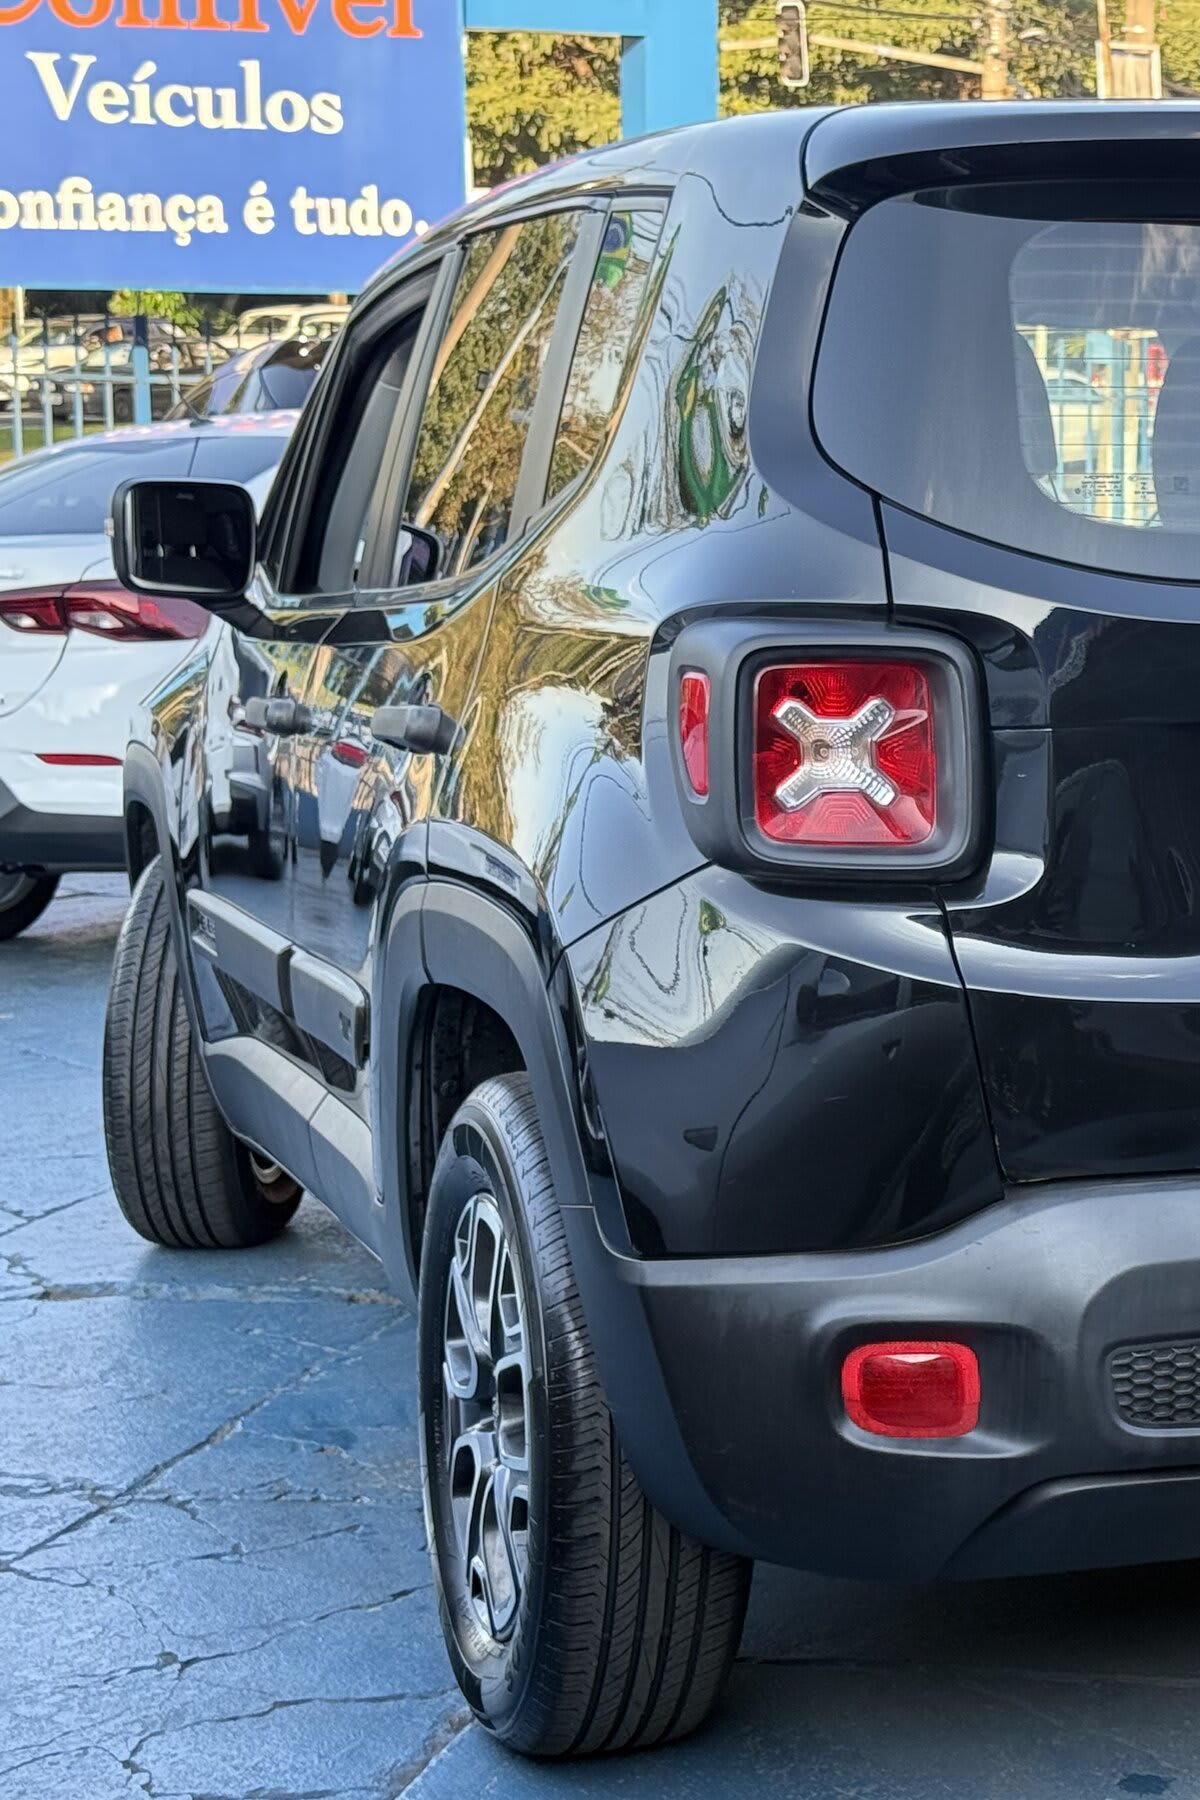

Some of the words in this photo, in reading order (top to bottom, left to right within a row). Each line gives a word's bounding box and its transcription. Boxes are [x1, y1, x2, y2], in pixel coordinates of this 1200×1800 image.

[25, 51, 344, 135] Veículos
[243, 180, 276, 235] é
[289, 184, 429, 237] tudo.
